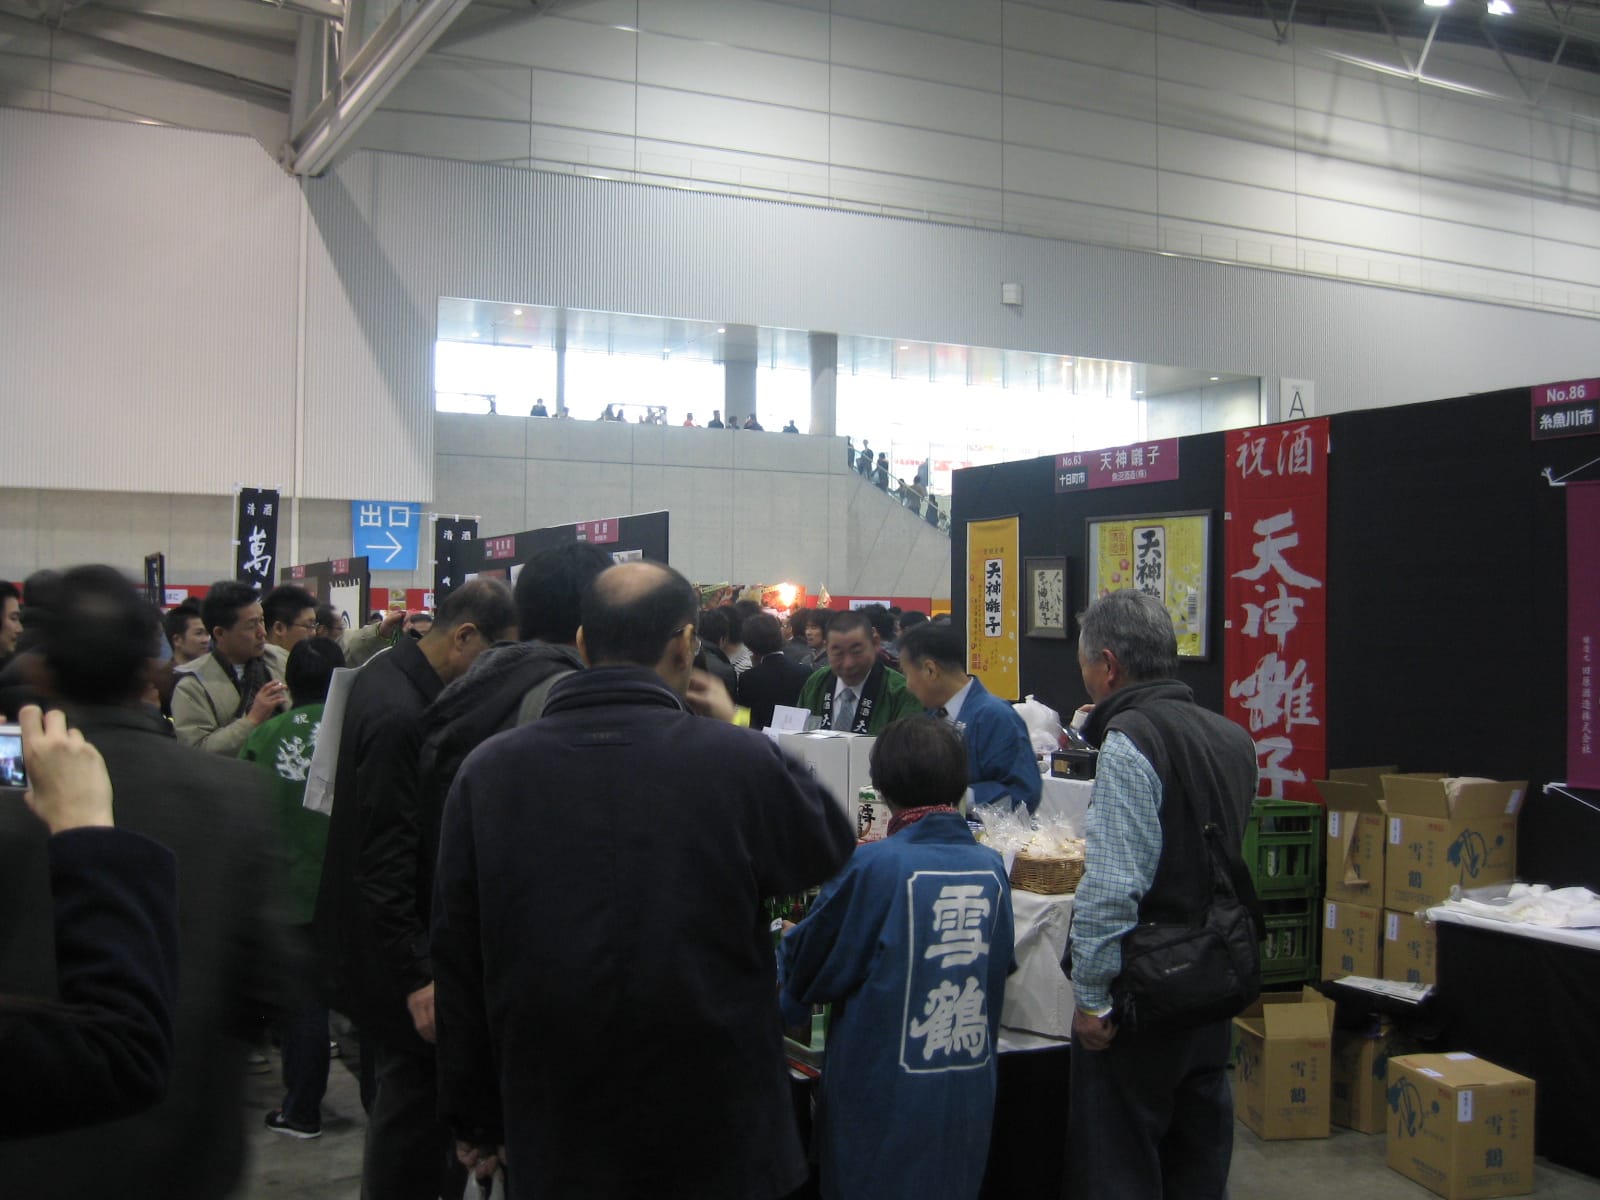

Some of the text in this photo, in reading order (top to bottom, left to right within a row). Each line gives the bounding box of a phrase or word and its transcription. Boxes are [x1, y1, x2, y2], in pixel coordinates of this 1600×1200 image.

[1289, 391, 1306, 418] A
[1546, 385, 1585, 403] No.86
[1540, 409, 1594, 430] 糸魚川市
[1062, 455, 1082, 467] No.63
[1236, 425, 1312, 479] 祝酒
[1059, 471, 1086, 487] 十日町市
[247, 503, 273, 516] 清酒
[360, 504, 409, 528] 出口
[243, 525, 272, 588] 萬
[1231, 509, 1322, 800] 天神囃子
[909, 885, 991, 1061] 雪鶴
